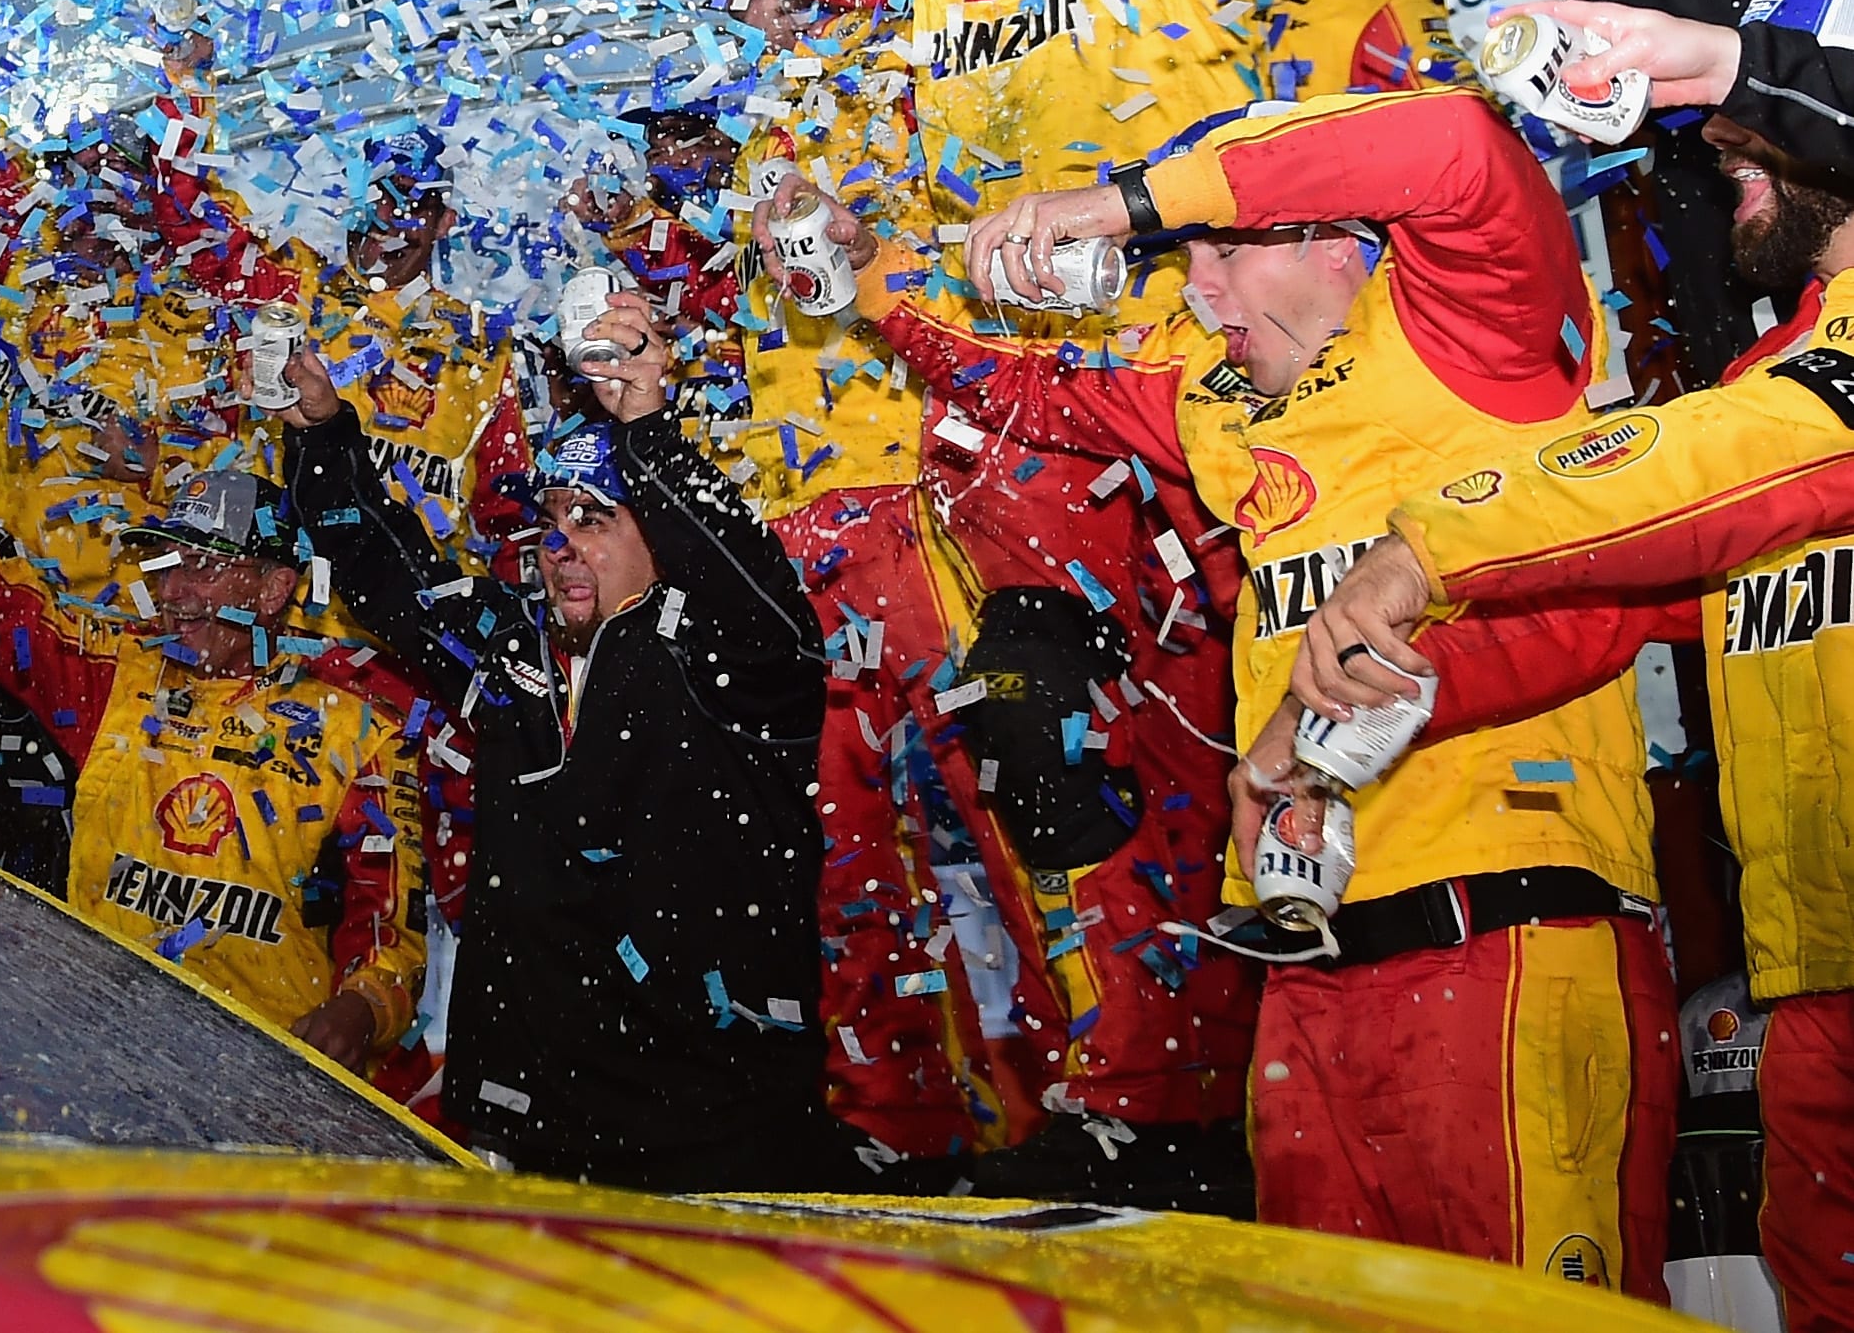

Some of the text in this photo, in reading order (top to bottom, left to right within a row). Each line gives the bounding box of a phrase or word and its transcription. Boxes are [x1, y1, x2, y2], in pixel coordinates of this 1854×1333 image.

[1296, 357, 1355, 403] SKF
[1556, 424, 1640, 469] PENNZOIL
[275, 702, 313, 722] Ford
[106, 853, 284, 944] PENNZOIL
